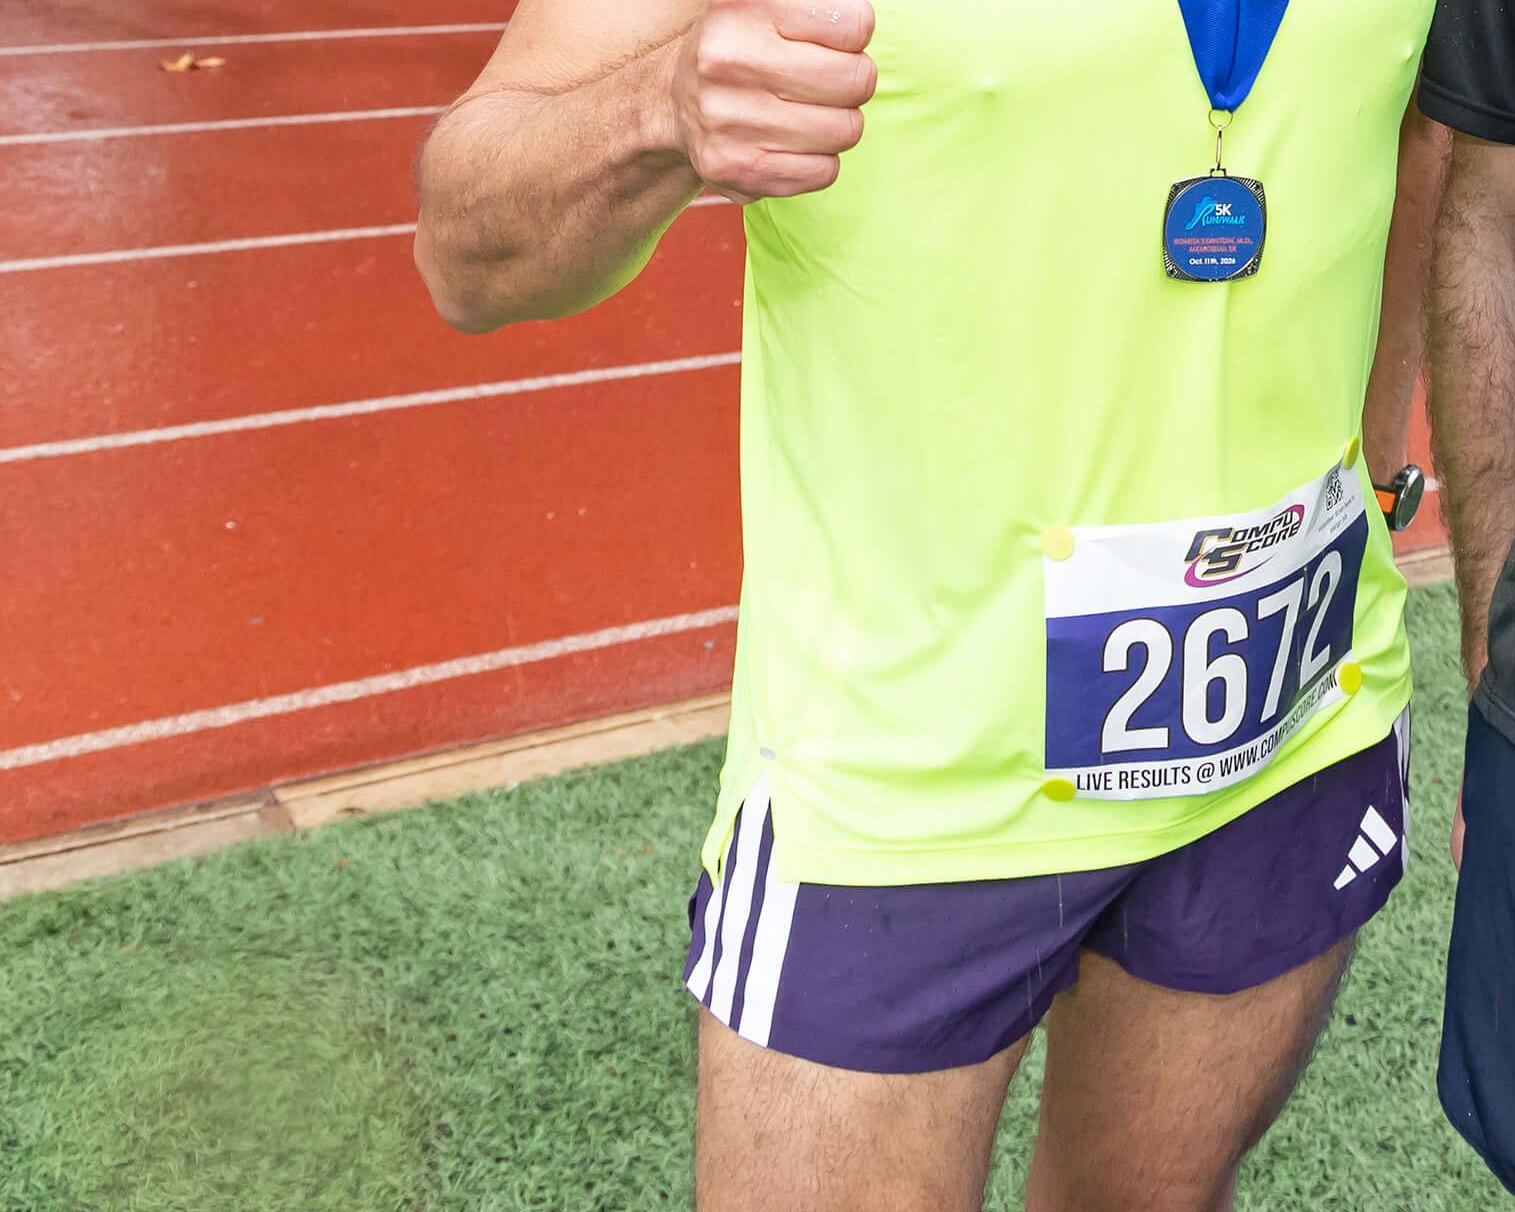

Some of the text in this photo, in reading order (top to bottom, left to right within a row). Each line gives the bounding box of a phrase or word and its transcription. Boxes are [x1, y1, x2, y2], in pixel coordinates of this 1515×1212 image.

[1215, 203, 1232, 216] 5K
[1101, 550, 1343, 755] 2672
[1076, 771, 1112, 791] LIVE
[1119, 765, 1191, 789] RESULTS
[1196, 762, 1215, 784] @
